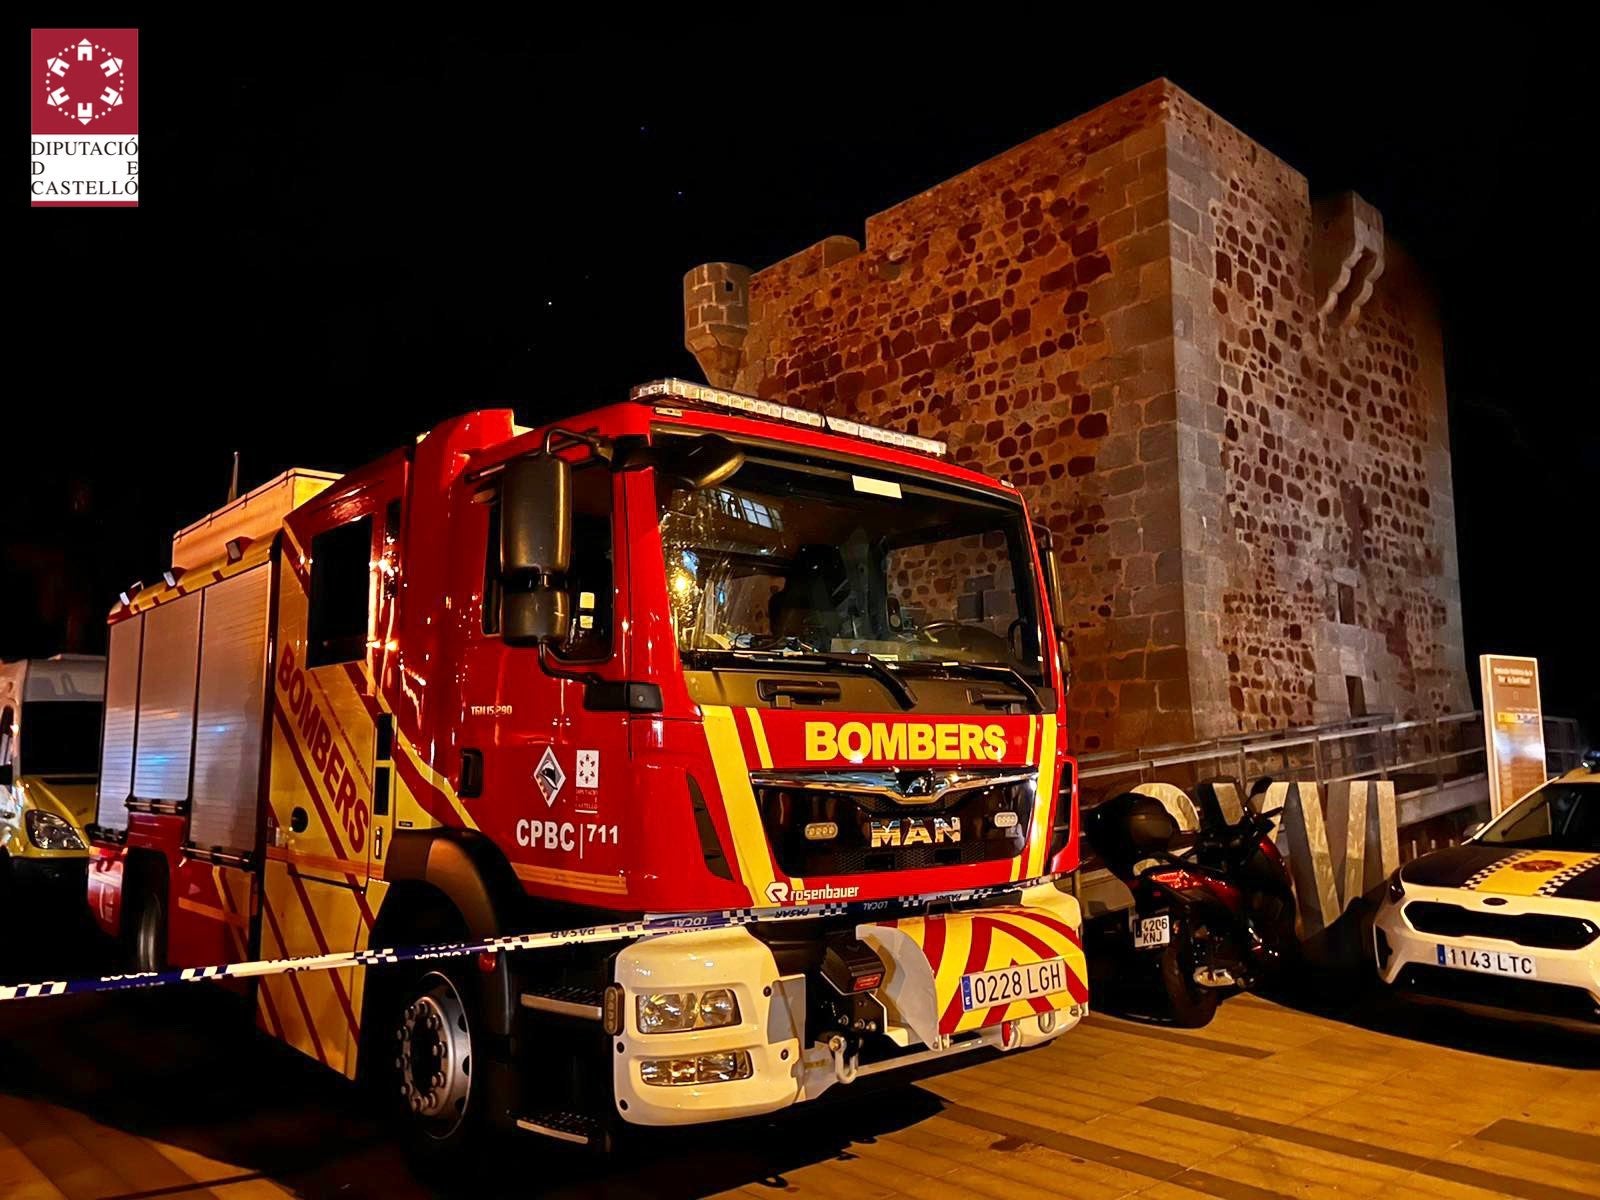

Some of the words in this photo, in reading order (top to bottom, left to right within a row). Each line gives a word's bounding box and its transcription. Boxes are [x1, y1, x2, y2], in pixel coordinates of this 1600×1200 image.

[277, 641, 369, 854] BOMBERS
[804, 720, 1007, 762] BOMBERS
[516, 818, 575, 851] CPBC
[586, 824, 618, 844] 711
[870, 816, 961, 848] MAN
[790, 884, 860, 901] rosenbauer
[774, 907, 810, 919] PASAR
[863, 900, 889, 911] LOCAL
[671, 916, 708, 928] LOCAL
[1143, 918, 1168, 931] 4206
[1143, 931, 1162, 944] KNJ
[1450, 948, 1491, 969] 1143
[1497, 954, 1533, 974] LTC
[974, 970, 1023, 1004] 0228
[1026, 962, 1062, 994] LGH
